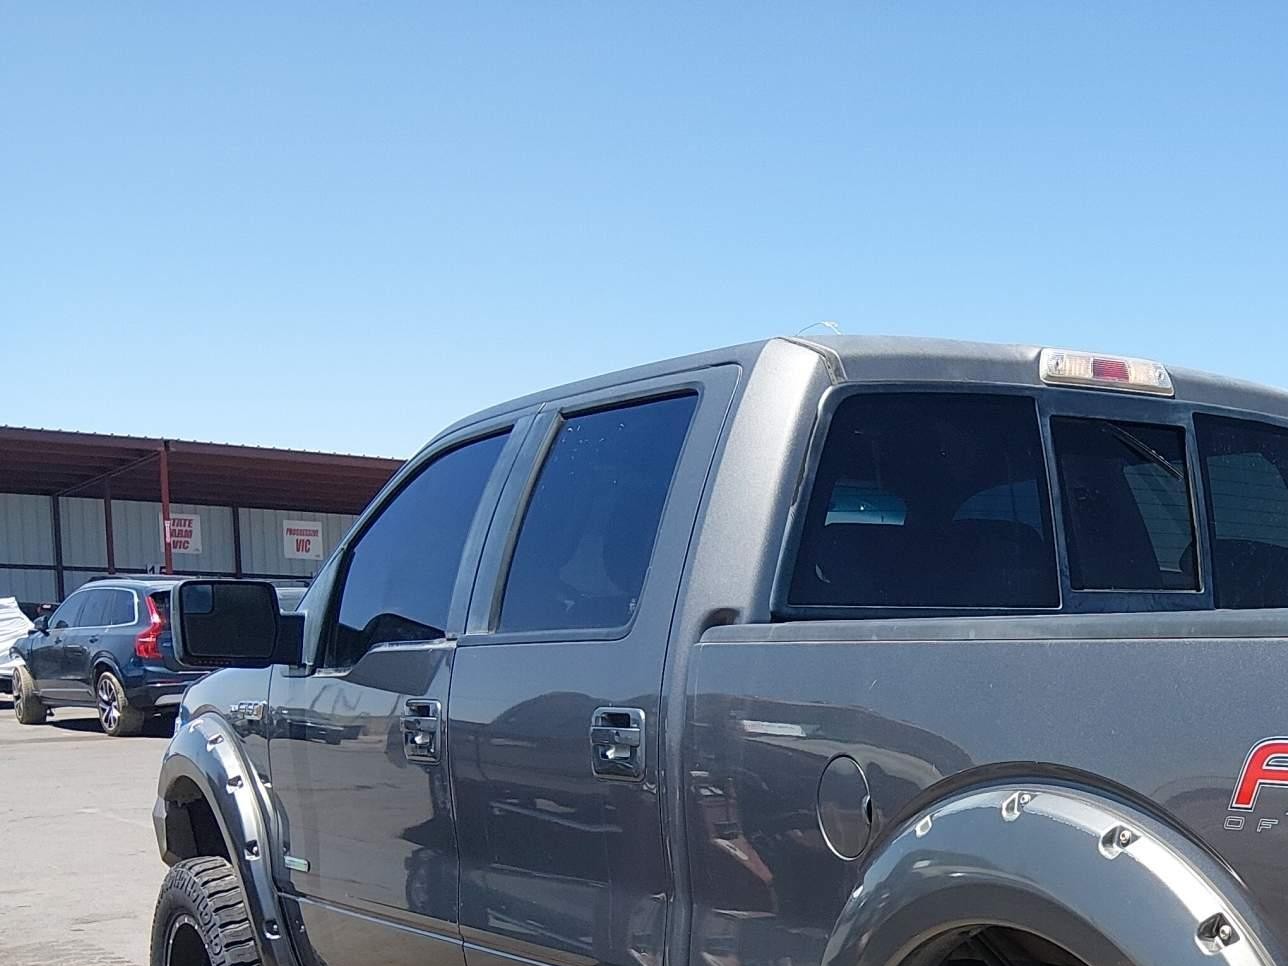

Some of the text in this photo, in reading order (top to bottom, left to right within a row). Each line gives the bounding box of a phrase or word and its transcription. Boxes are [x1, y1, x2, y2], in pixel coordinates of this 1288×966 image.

[170, 518, 193, 528] TATE
[169, 528, 193, 539] ARM
[172, 539, 190, 550] VIC
[295, 538, 311, 553] VIC
